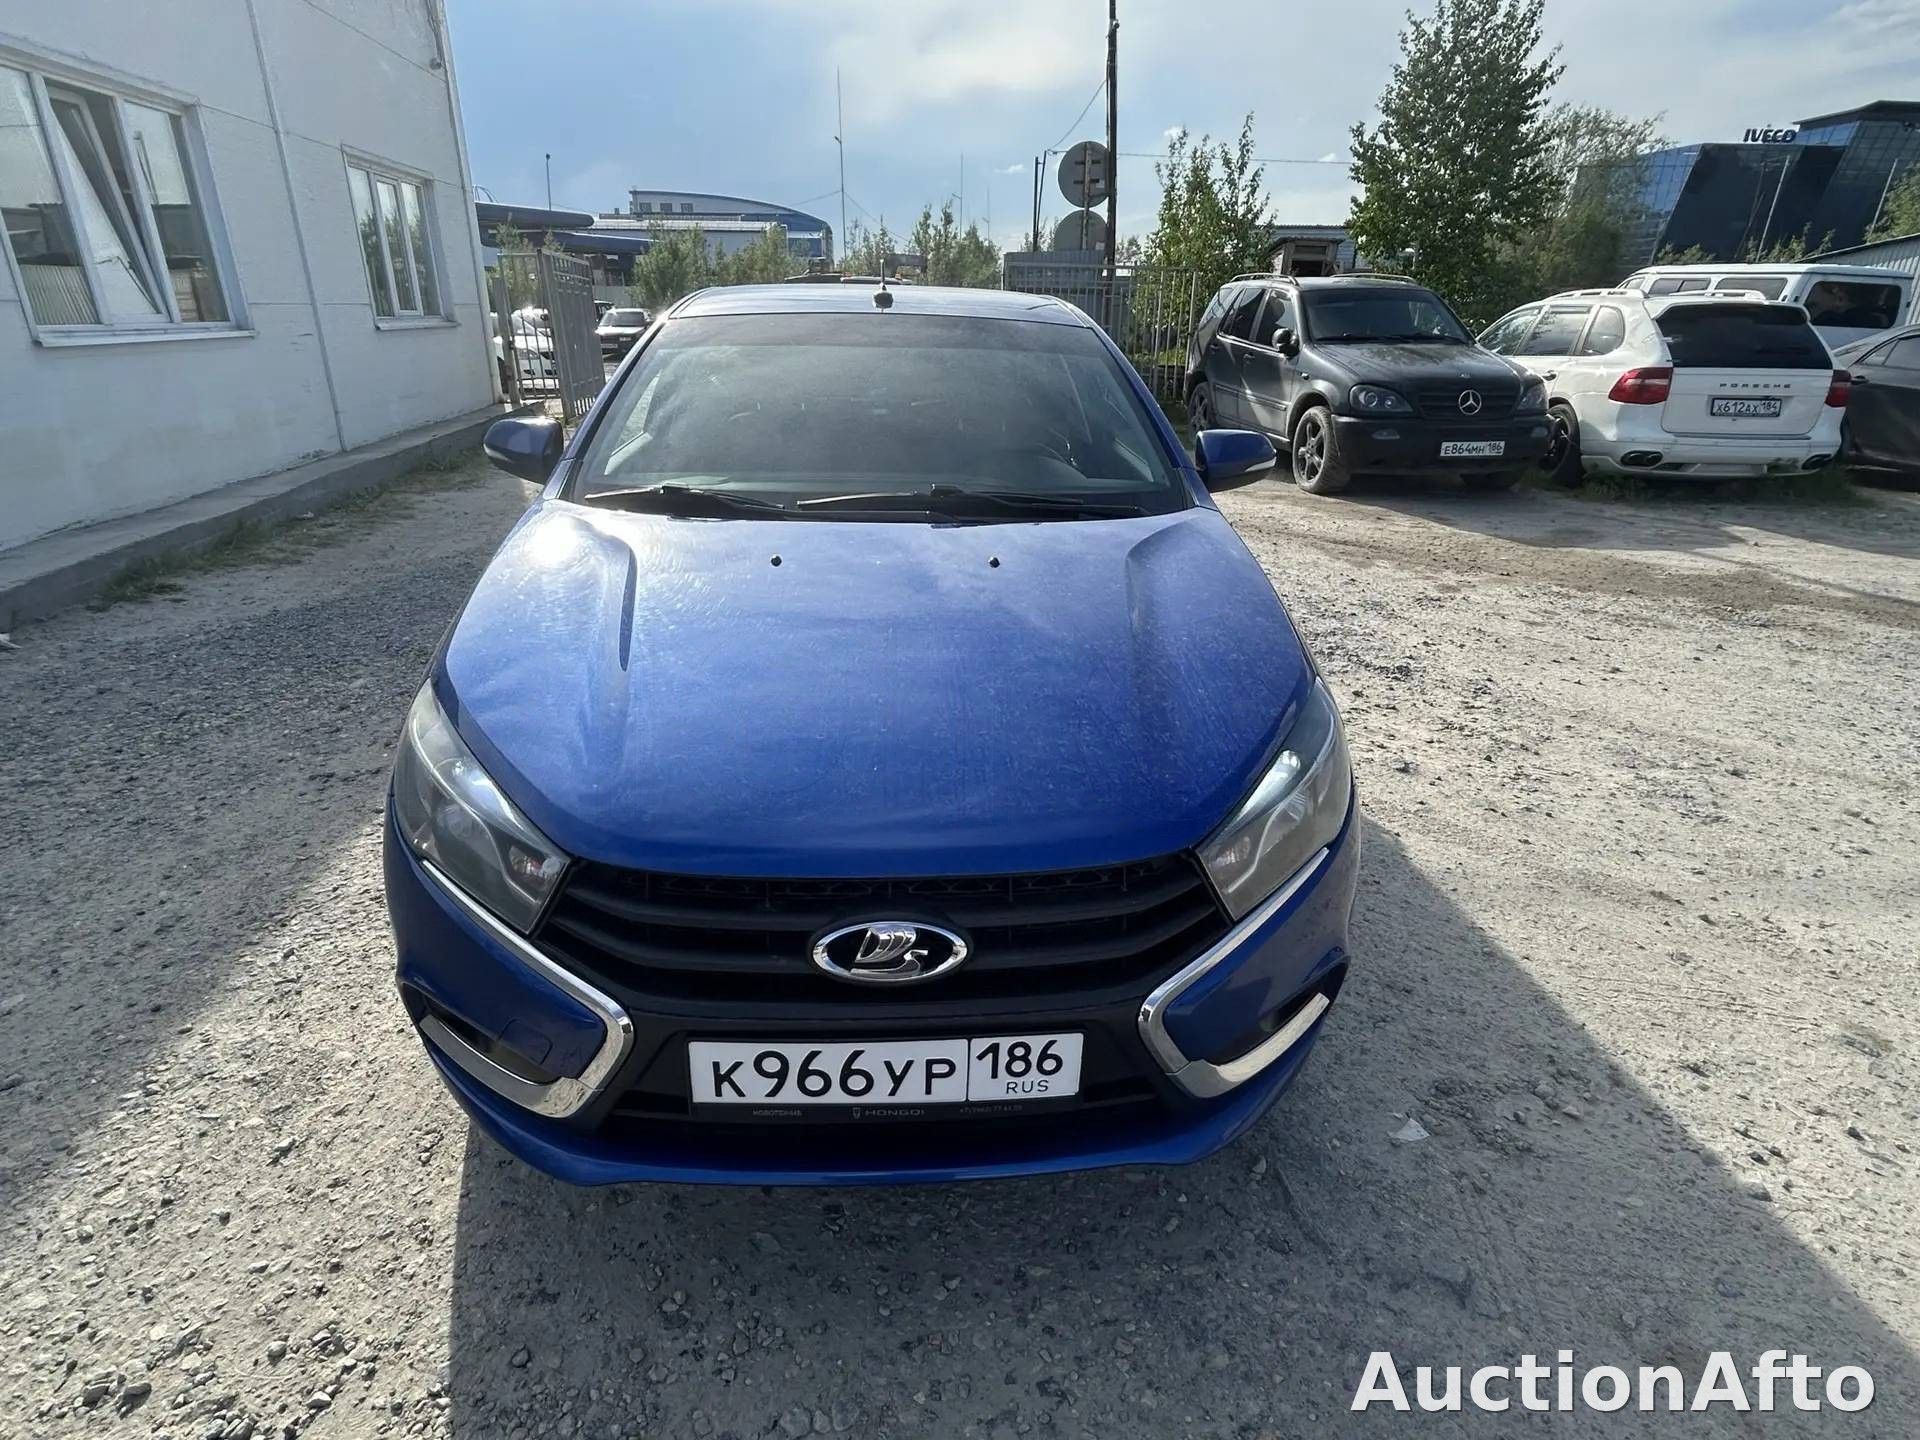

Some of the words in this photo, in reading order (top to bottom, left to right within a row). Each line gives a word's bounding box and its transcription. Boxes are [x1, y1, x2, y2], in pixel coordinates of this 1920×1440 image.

[1743, 129, 1797, 143] IVECO
[975, 1039, 1064, 1080] 186
[1006, 1079, 1050, 1094] RUS
[864, 1108, 926, 1117] HONGQI
